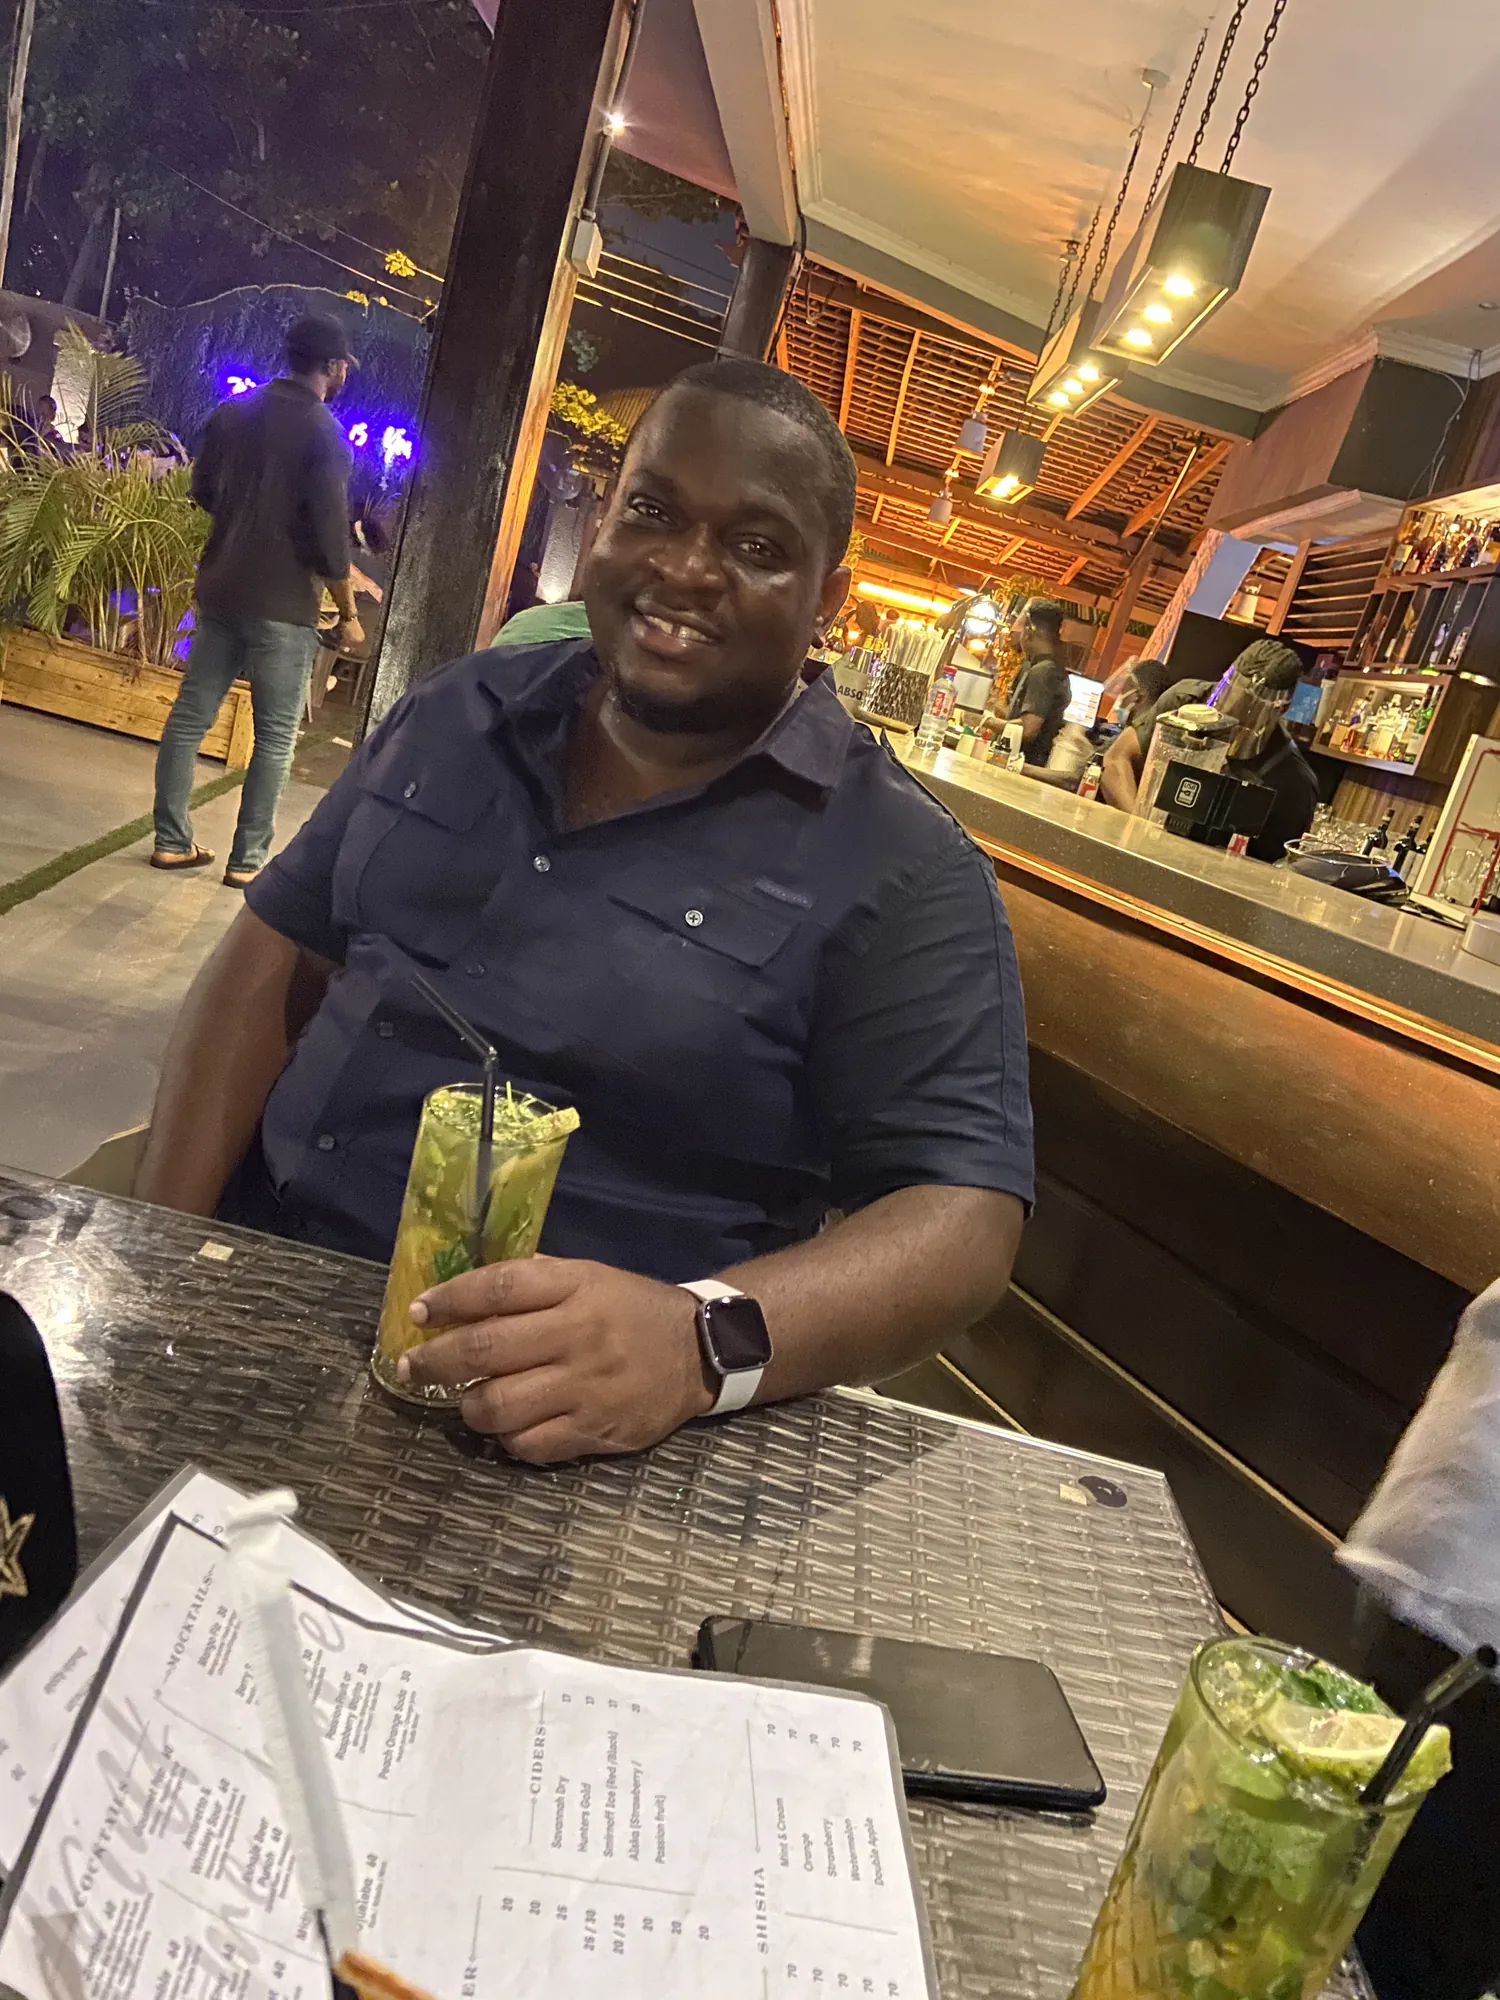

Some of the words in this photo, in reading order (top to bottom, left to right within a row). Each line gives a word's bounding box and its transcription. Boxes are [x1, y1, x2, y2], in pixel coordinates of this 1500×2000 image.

[837, 685, 863, 700] ABSO
[167, 1574, 212, 1670] MOCKTAILS
[385, 1714, 403, 1748] Orange
[831, 1737, 840, 1748] 70
[853, 1740, 862, 1752] 70
[530, 1724, 545, 1795] CIDERS
[555, 1776, 569, 1794] Dry
[580, 1782, 591, 1809] Gold
[551, 1796, 565, 1849] Savannah
[776, 1798, 786, 1829] Cream
[74, 1779, 133, 1908] COCKTAILS
[578, 1811, 590, 1852] Hunters
[655, 1824, 665, 1864] Passion
[824, 1818, 837, 1877] Strawberry
[864, 1817, 878, 1850] Apple
[802, 1833, 814, 1872] Orange
[844, 1818, 860, 1881] Watermelon
[870, 1848, 884, 1886] Double
[754, 1868, 768, 1953] SHISHA
[787, 1964, 797, 1978] 70
[812, 1968, 823, 1982] 70
[837, 1973, 848, 1987] 70
[862, 1978, 873, 1992] 70
[888, 1982, 899, 1996] 70
